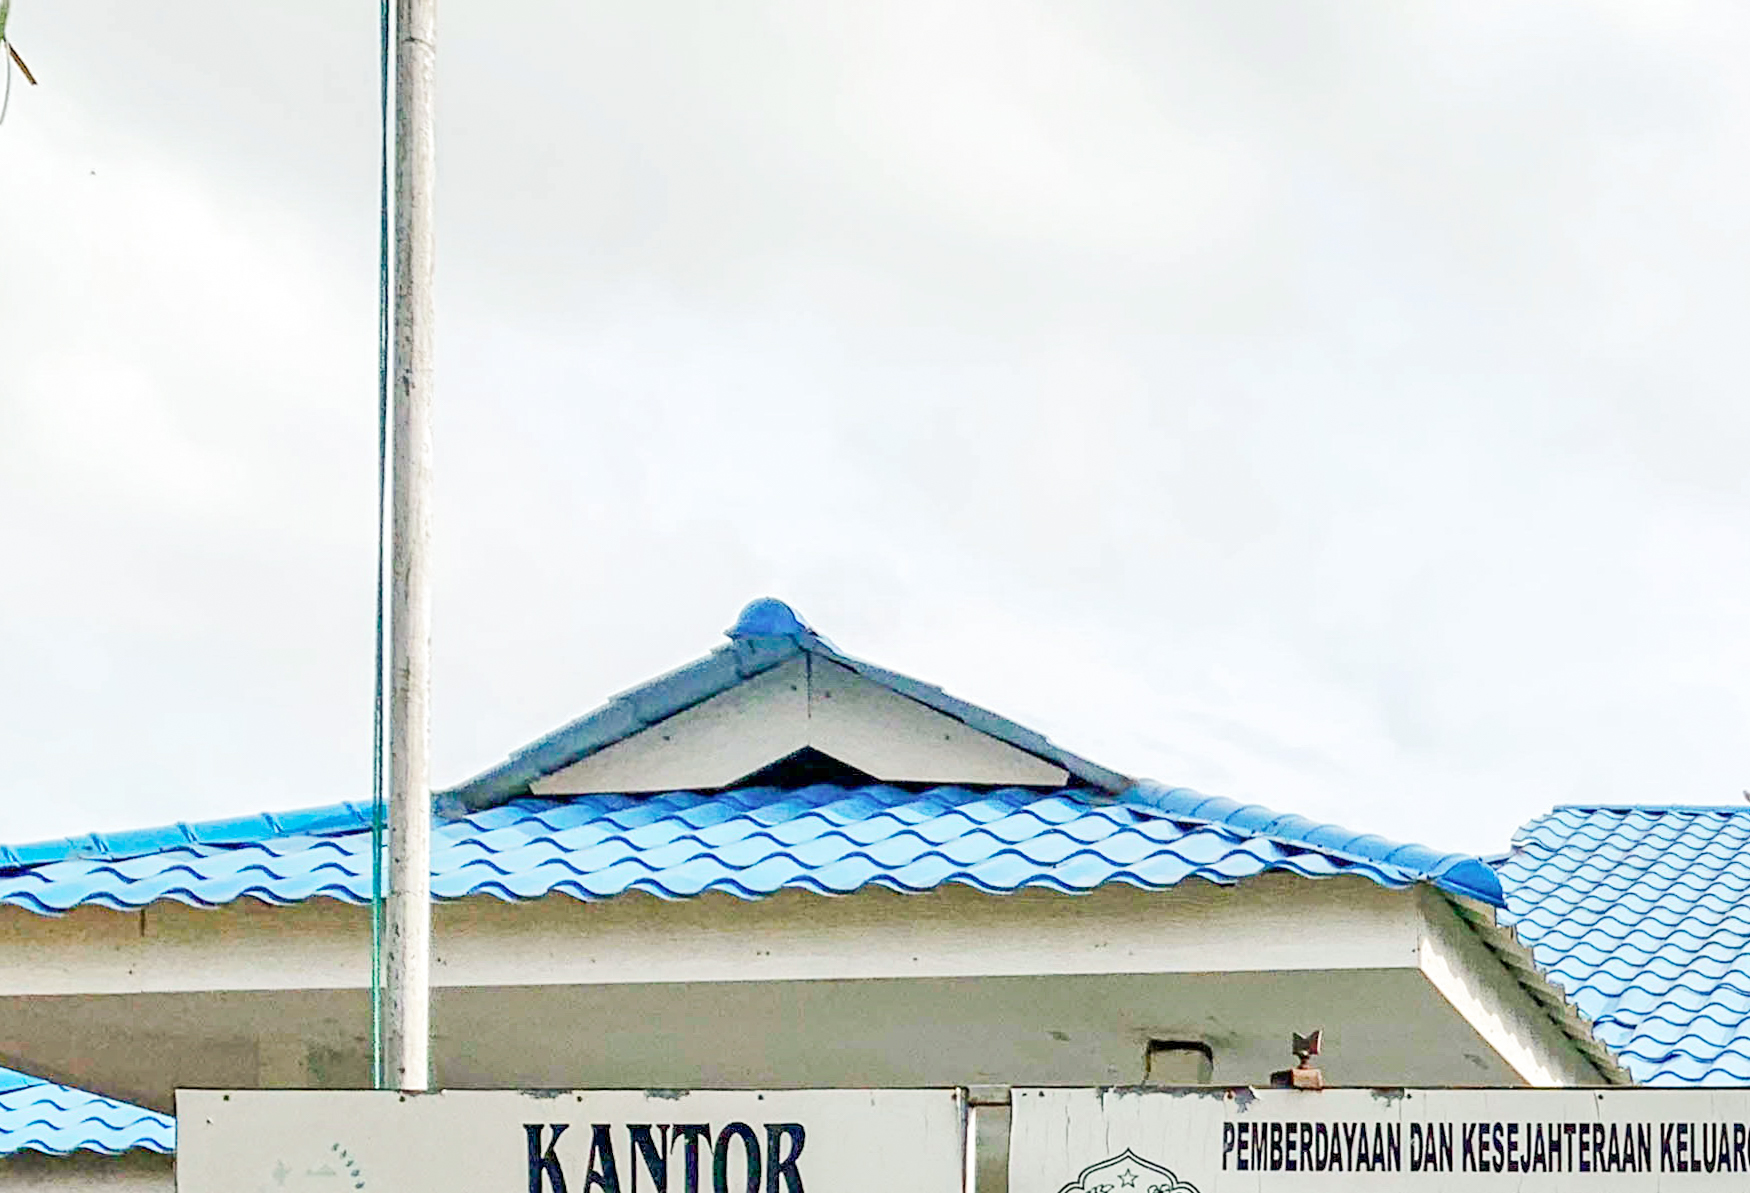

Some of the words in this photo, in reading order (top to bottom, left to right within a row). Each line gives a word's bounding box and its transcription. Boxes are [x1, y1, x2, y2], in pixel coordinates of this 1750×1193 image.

[1223, 1122, 1400, 1171] PEMBERDAYAAN
[1411, 1123, 1452, 1172] DAN
[1463, 1122, 1651, 1173] KESEJAHTERAAN
